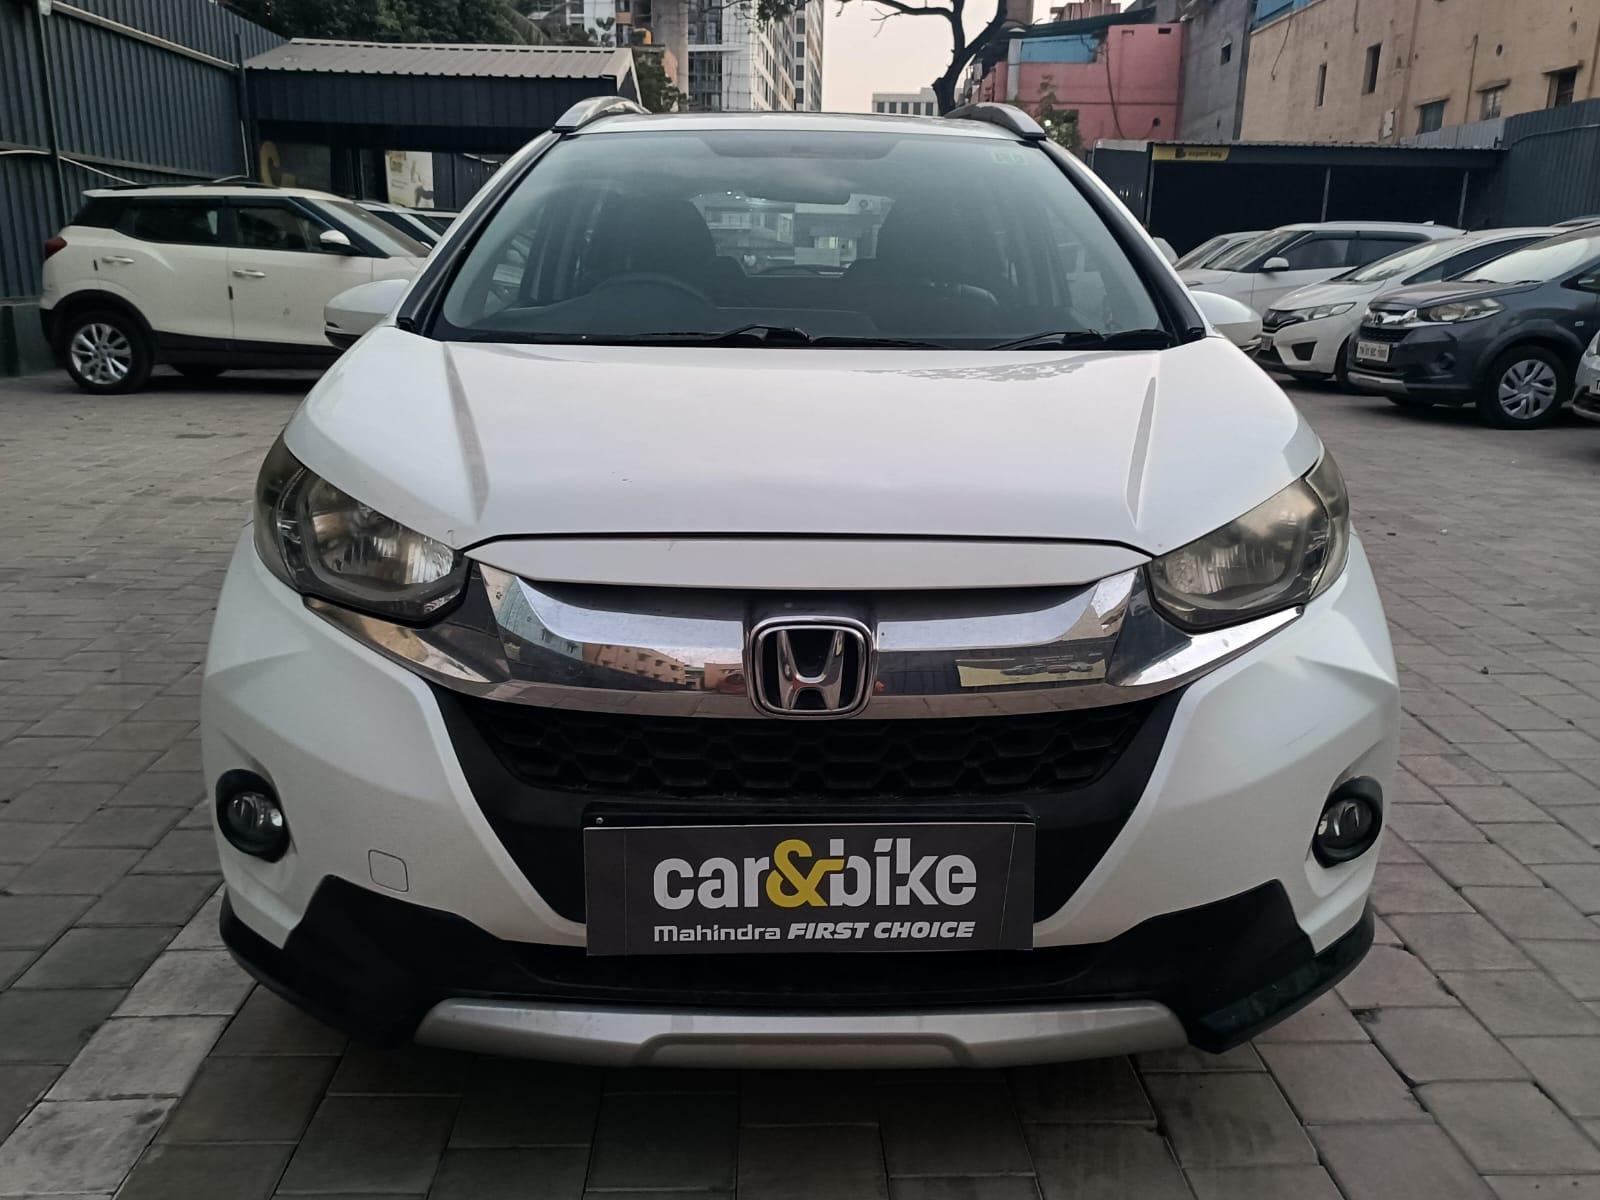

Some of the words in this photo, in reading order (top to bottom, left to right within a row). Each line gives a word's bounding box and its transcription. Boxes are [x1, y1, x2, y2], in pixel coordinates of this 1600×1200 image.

[653, 838, 977, 910] car&bike
[653, 924, 781, 942] Mahindra
[787, 922, 870, 940] FIRST
[873, 921, 976, 939] CHOICE
